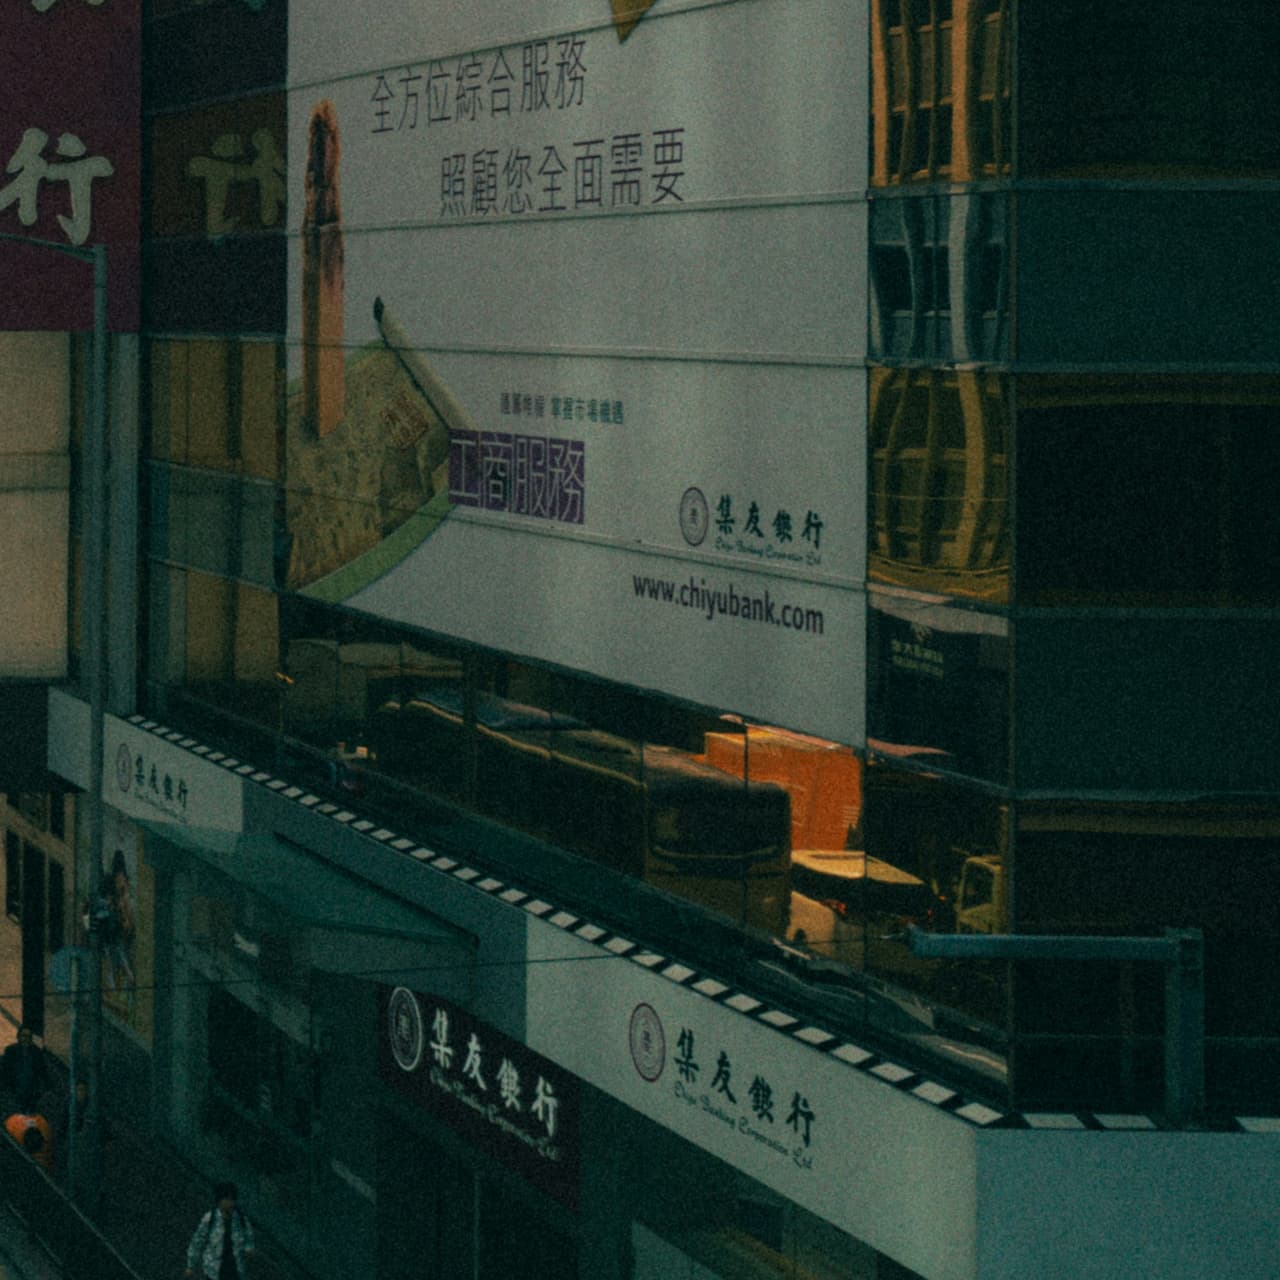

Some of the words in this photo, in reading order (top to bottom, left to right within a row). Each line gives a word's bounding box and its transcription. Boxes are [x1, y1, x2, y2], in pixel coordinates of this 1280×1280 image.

[370, 33, 588, 134] 全方位綜合服務
[441, 127, 685, 216] 照顧您全面需要
[448, 431, 585, 525] 工商服務
[715, 493, 824, 549] 集友銀行
[632, 574, 825, 635] www.chiyubank.com
[430, 1007, 558, 1137] 集友銀行
[673, 1026, 816, 1148] 集友銀行
